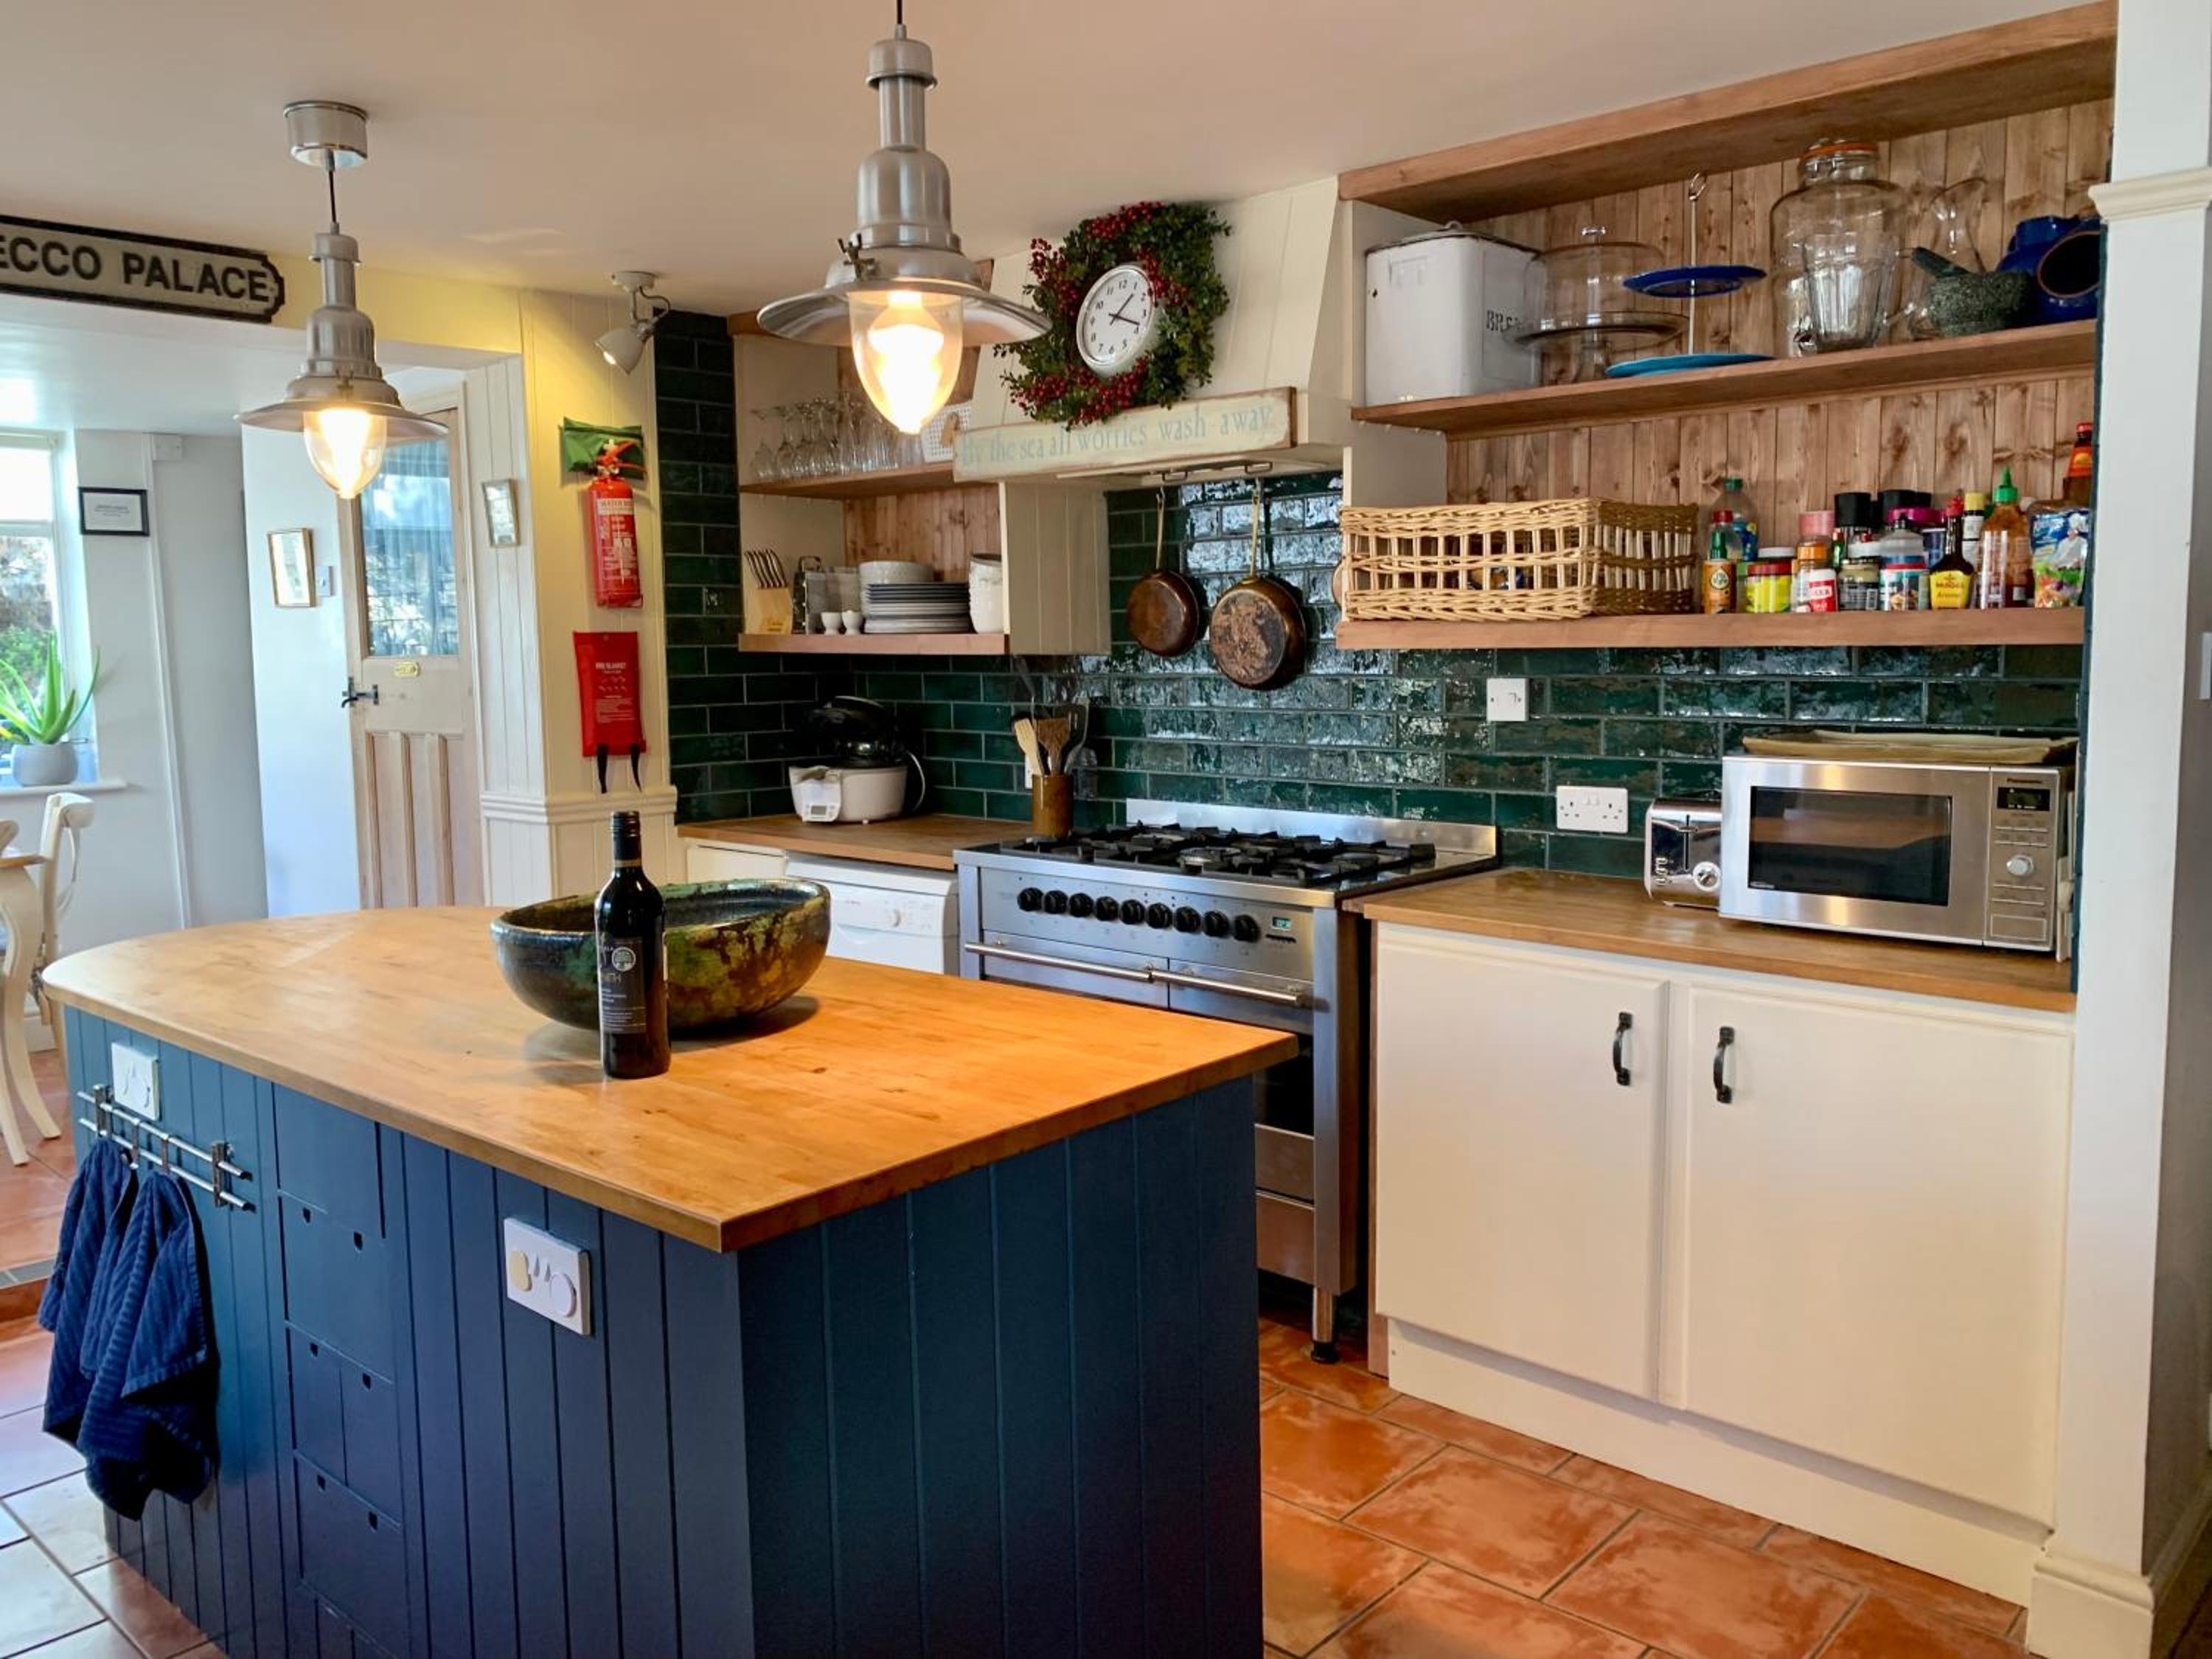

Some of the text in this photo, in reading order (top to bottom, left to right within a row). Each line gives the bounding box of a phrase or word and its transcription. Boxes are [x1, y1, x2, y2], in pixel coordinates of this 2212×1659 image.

[122, 251, 270, 303] PALACE
[990, 430, 1016, 462] the
[1019, 438, 1046, 461] sea
[1049, 427, 1071, 456] all
[1077, 423, 1147, 452] worries
[1158, 406, 1208, 441] wash
[1220, 406, 1274, 437] away
